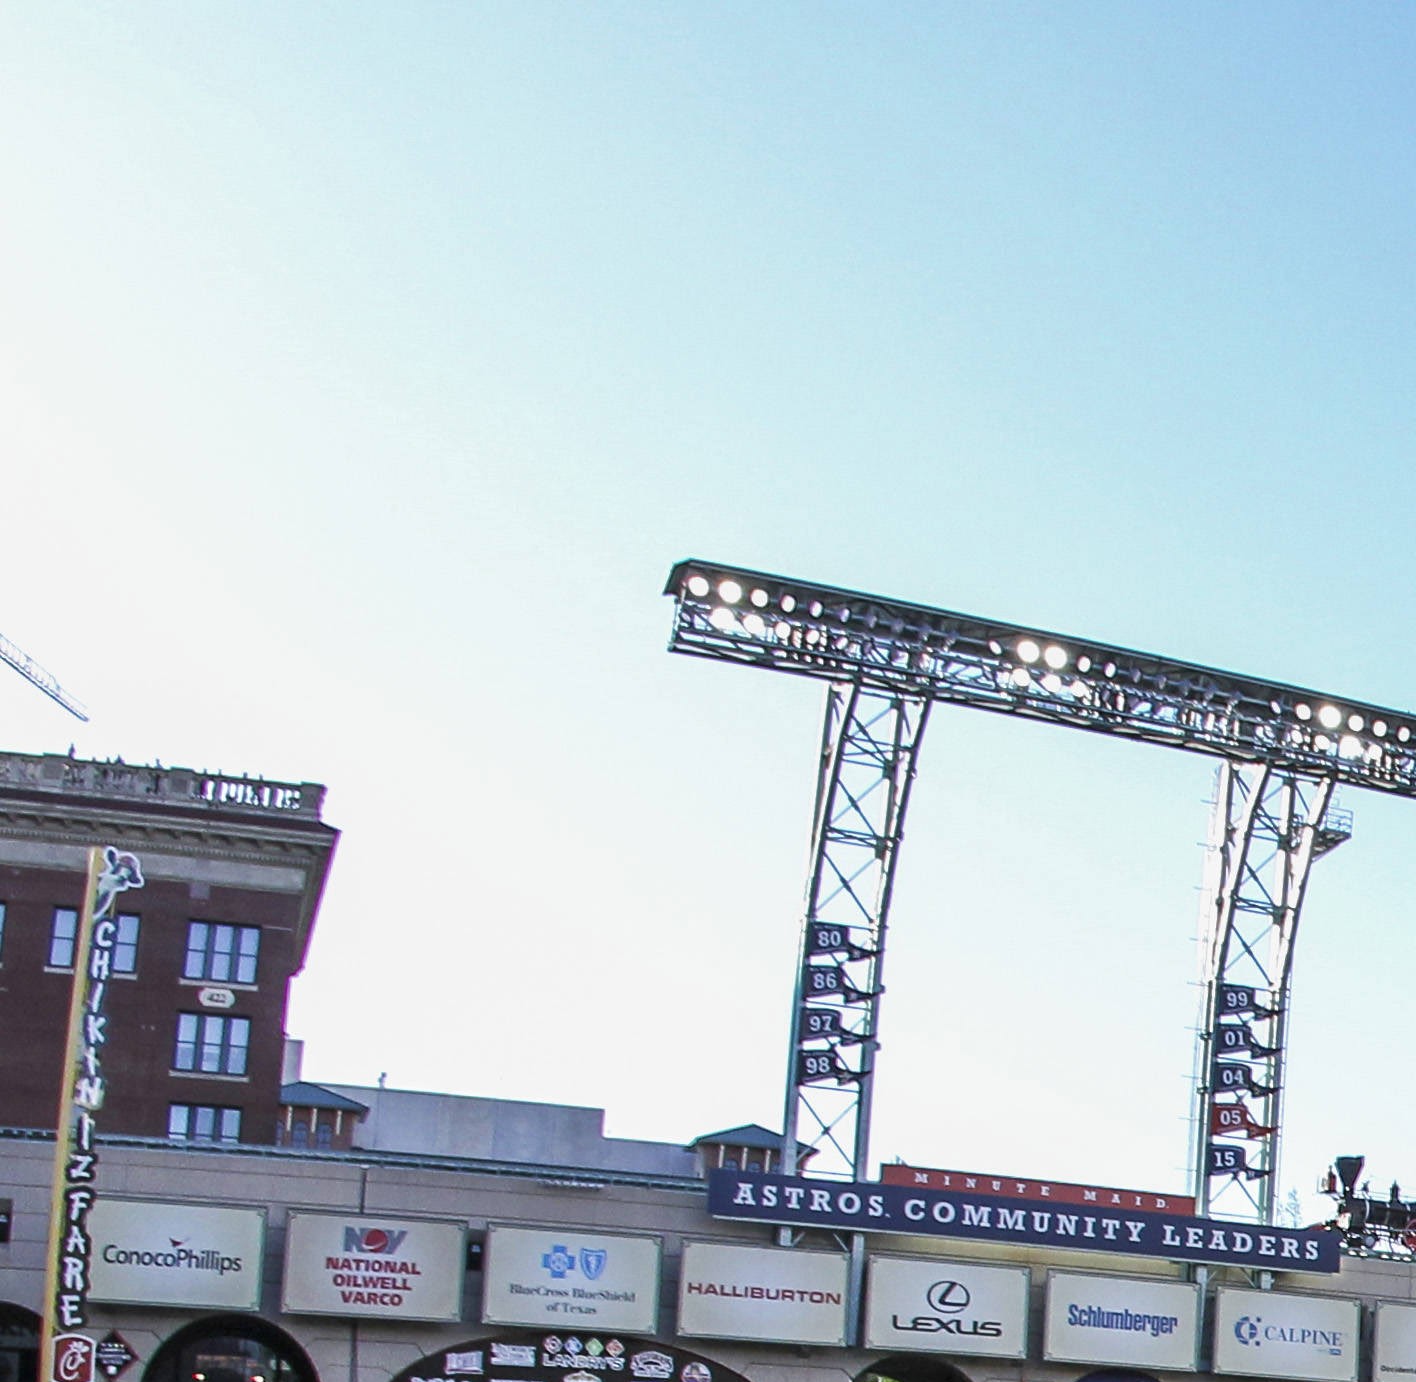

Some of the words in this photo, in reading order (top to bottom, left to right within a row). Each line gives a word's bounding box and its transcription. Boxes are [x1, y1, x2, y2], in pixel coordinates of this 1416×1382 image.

[818, 931, 841, 947] 80
[813, 973, 837, 989] 86
[1226, 992, 1248, 1007] 99
[809, 1016, 832, 1032] 97
[1224, 1031, 1245, 1046] 01
[806, 1057, 830, 1074] 98
[1222, 1070, 1244, 1085] 04
[1220, 1111, 1241, 1126] 05
[1214, 1152, 1235, 1167] 15
[914, 1172, 1051, 1197] MINUTE
[1084, 1190, 1167, 1209] MAID
[734, 1182, 885, 1218] ASTROS
[904, 1199, 1146, 1243] COMMUNITY
[1163, 1224, 1320, 1261] LEADERS
[103, 1244, 242, 1276] ConocoPhillips
[325, 1257, 421, 1276] NATIONAL
[332, 1274, 412, 1292] OILWELL
[340, 1290, 403, 1307] VARCO
[509, 1283, 570, 1299] BlueCross
[572, 1287, 636, 1304] BlueShield
[688, 1282, 842, 1306] HALLIBURTON
[546, 1302, 560, 1313] of
[561, 1303, 598, 1316] Texas
[892, 1314, 1002, 1338] LEXUS
[1068, 1303, 1178, 1336] Schlumberger
[1264, 1325, 1344, 1347] CALPINE
[543, 1353, 626, 1371] LANDRY'S
